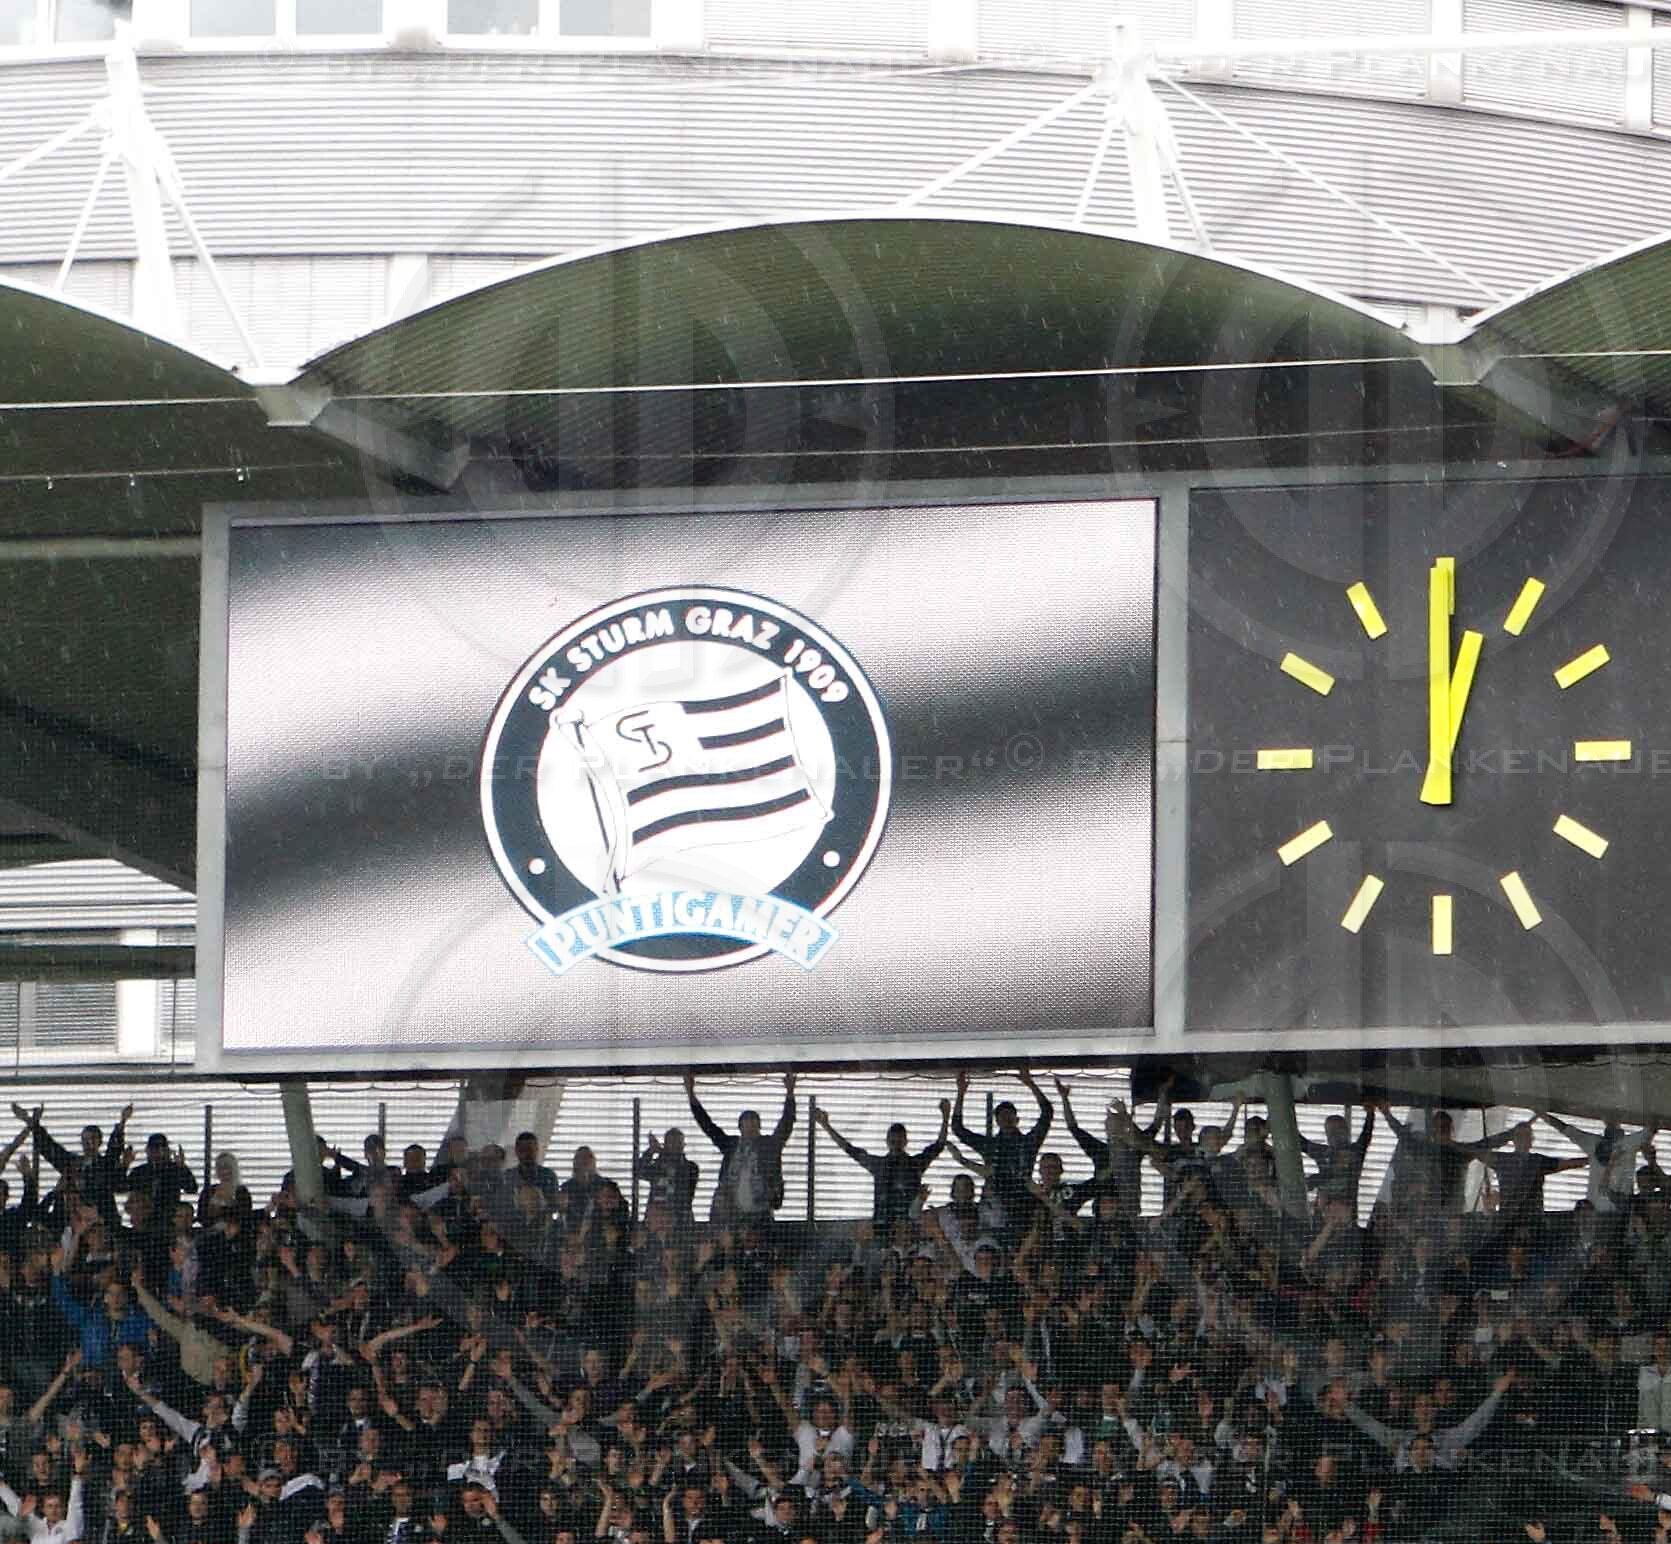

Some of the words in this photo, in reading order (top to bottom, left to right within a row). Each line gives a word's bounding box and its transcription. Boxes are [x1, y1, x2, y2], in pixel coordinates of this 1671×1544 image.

[530, 667, 572, 711] SK
[567, 609, 674, 673] STURM
[684, 606, 780, 650] GRAZ
[784, 640, 849, 704] 1909
[548, 892, 826, 960] PUNTIGAMER
